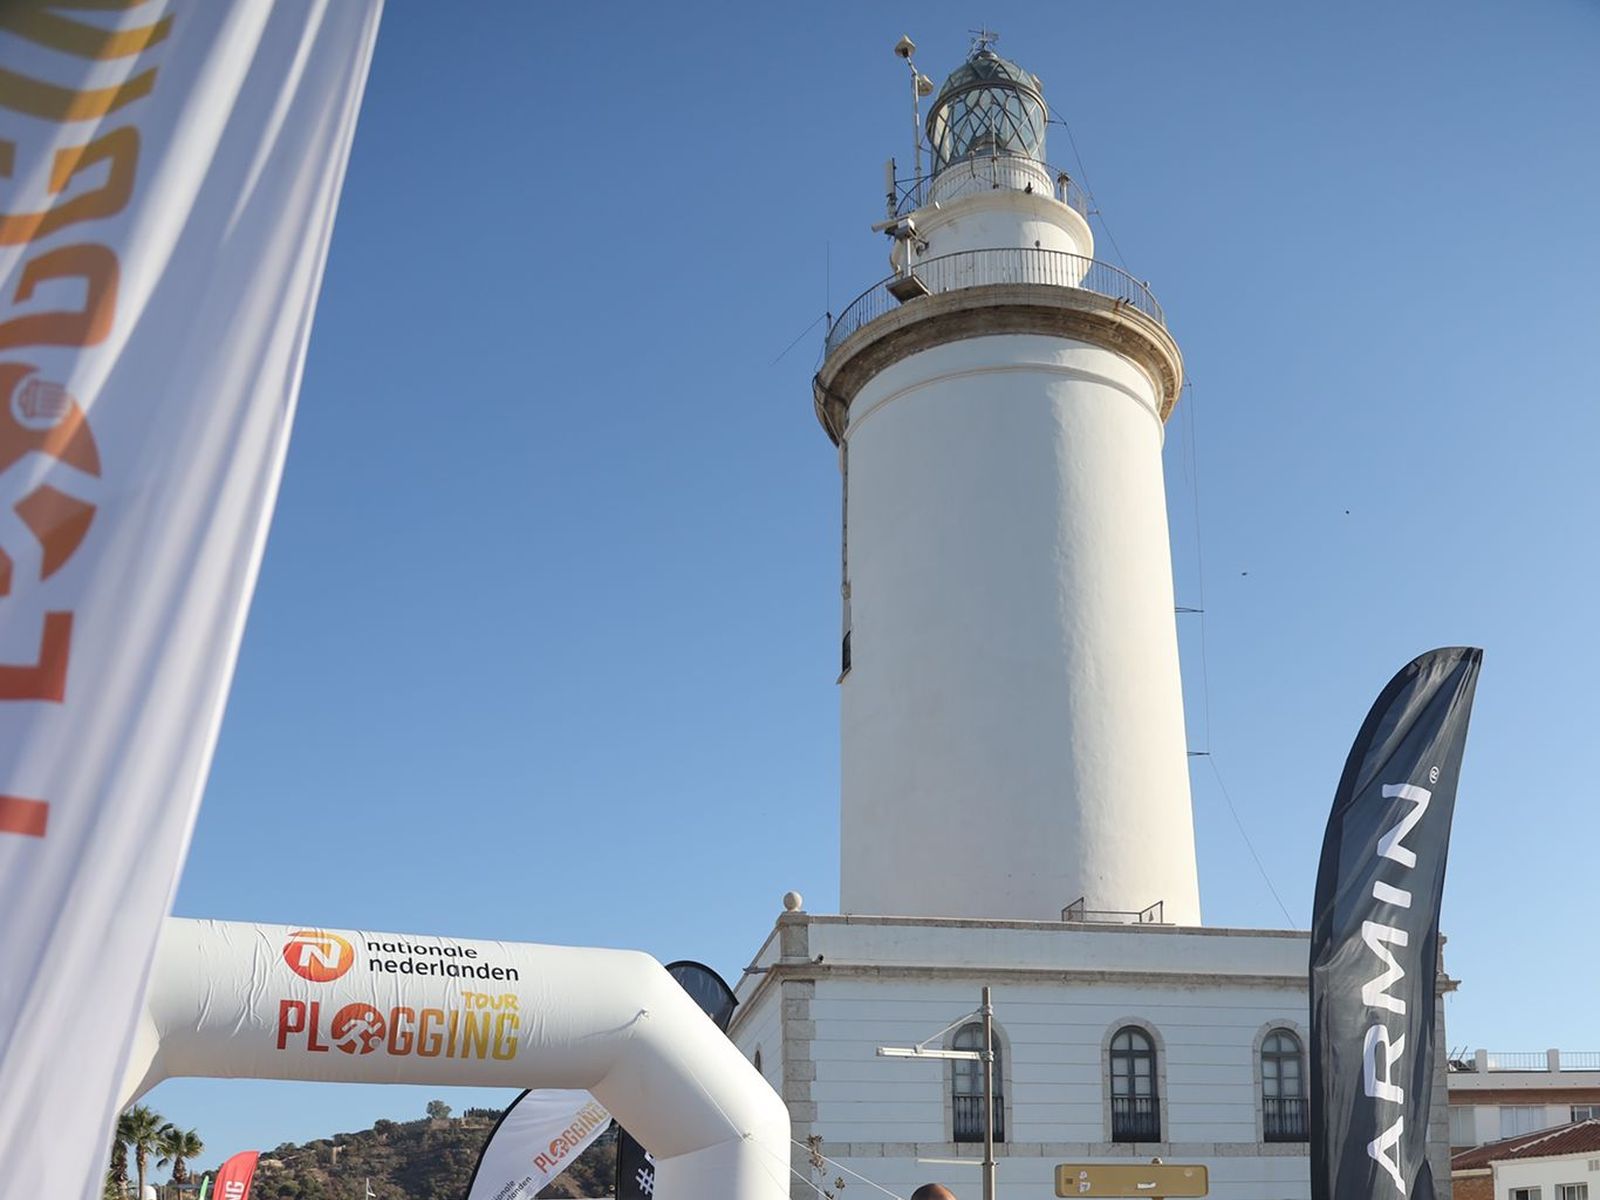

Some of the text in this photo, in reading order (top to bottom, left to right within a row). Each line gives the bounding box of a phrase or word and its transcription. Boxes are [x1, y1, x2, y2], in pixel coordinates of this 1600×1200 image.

[367, 941, 478, 959] nationale
[369, 957, 519, 981] nederlanden
[461, 990, 520, 1010] TOUR
